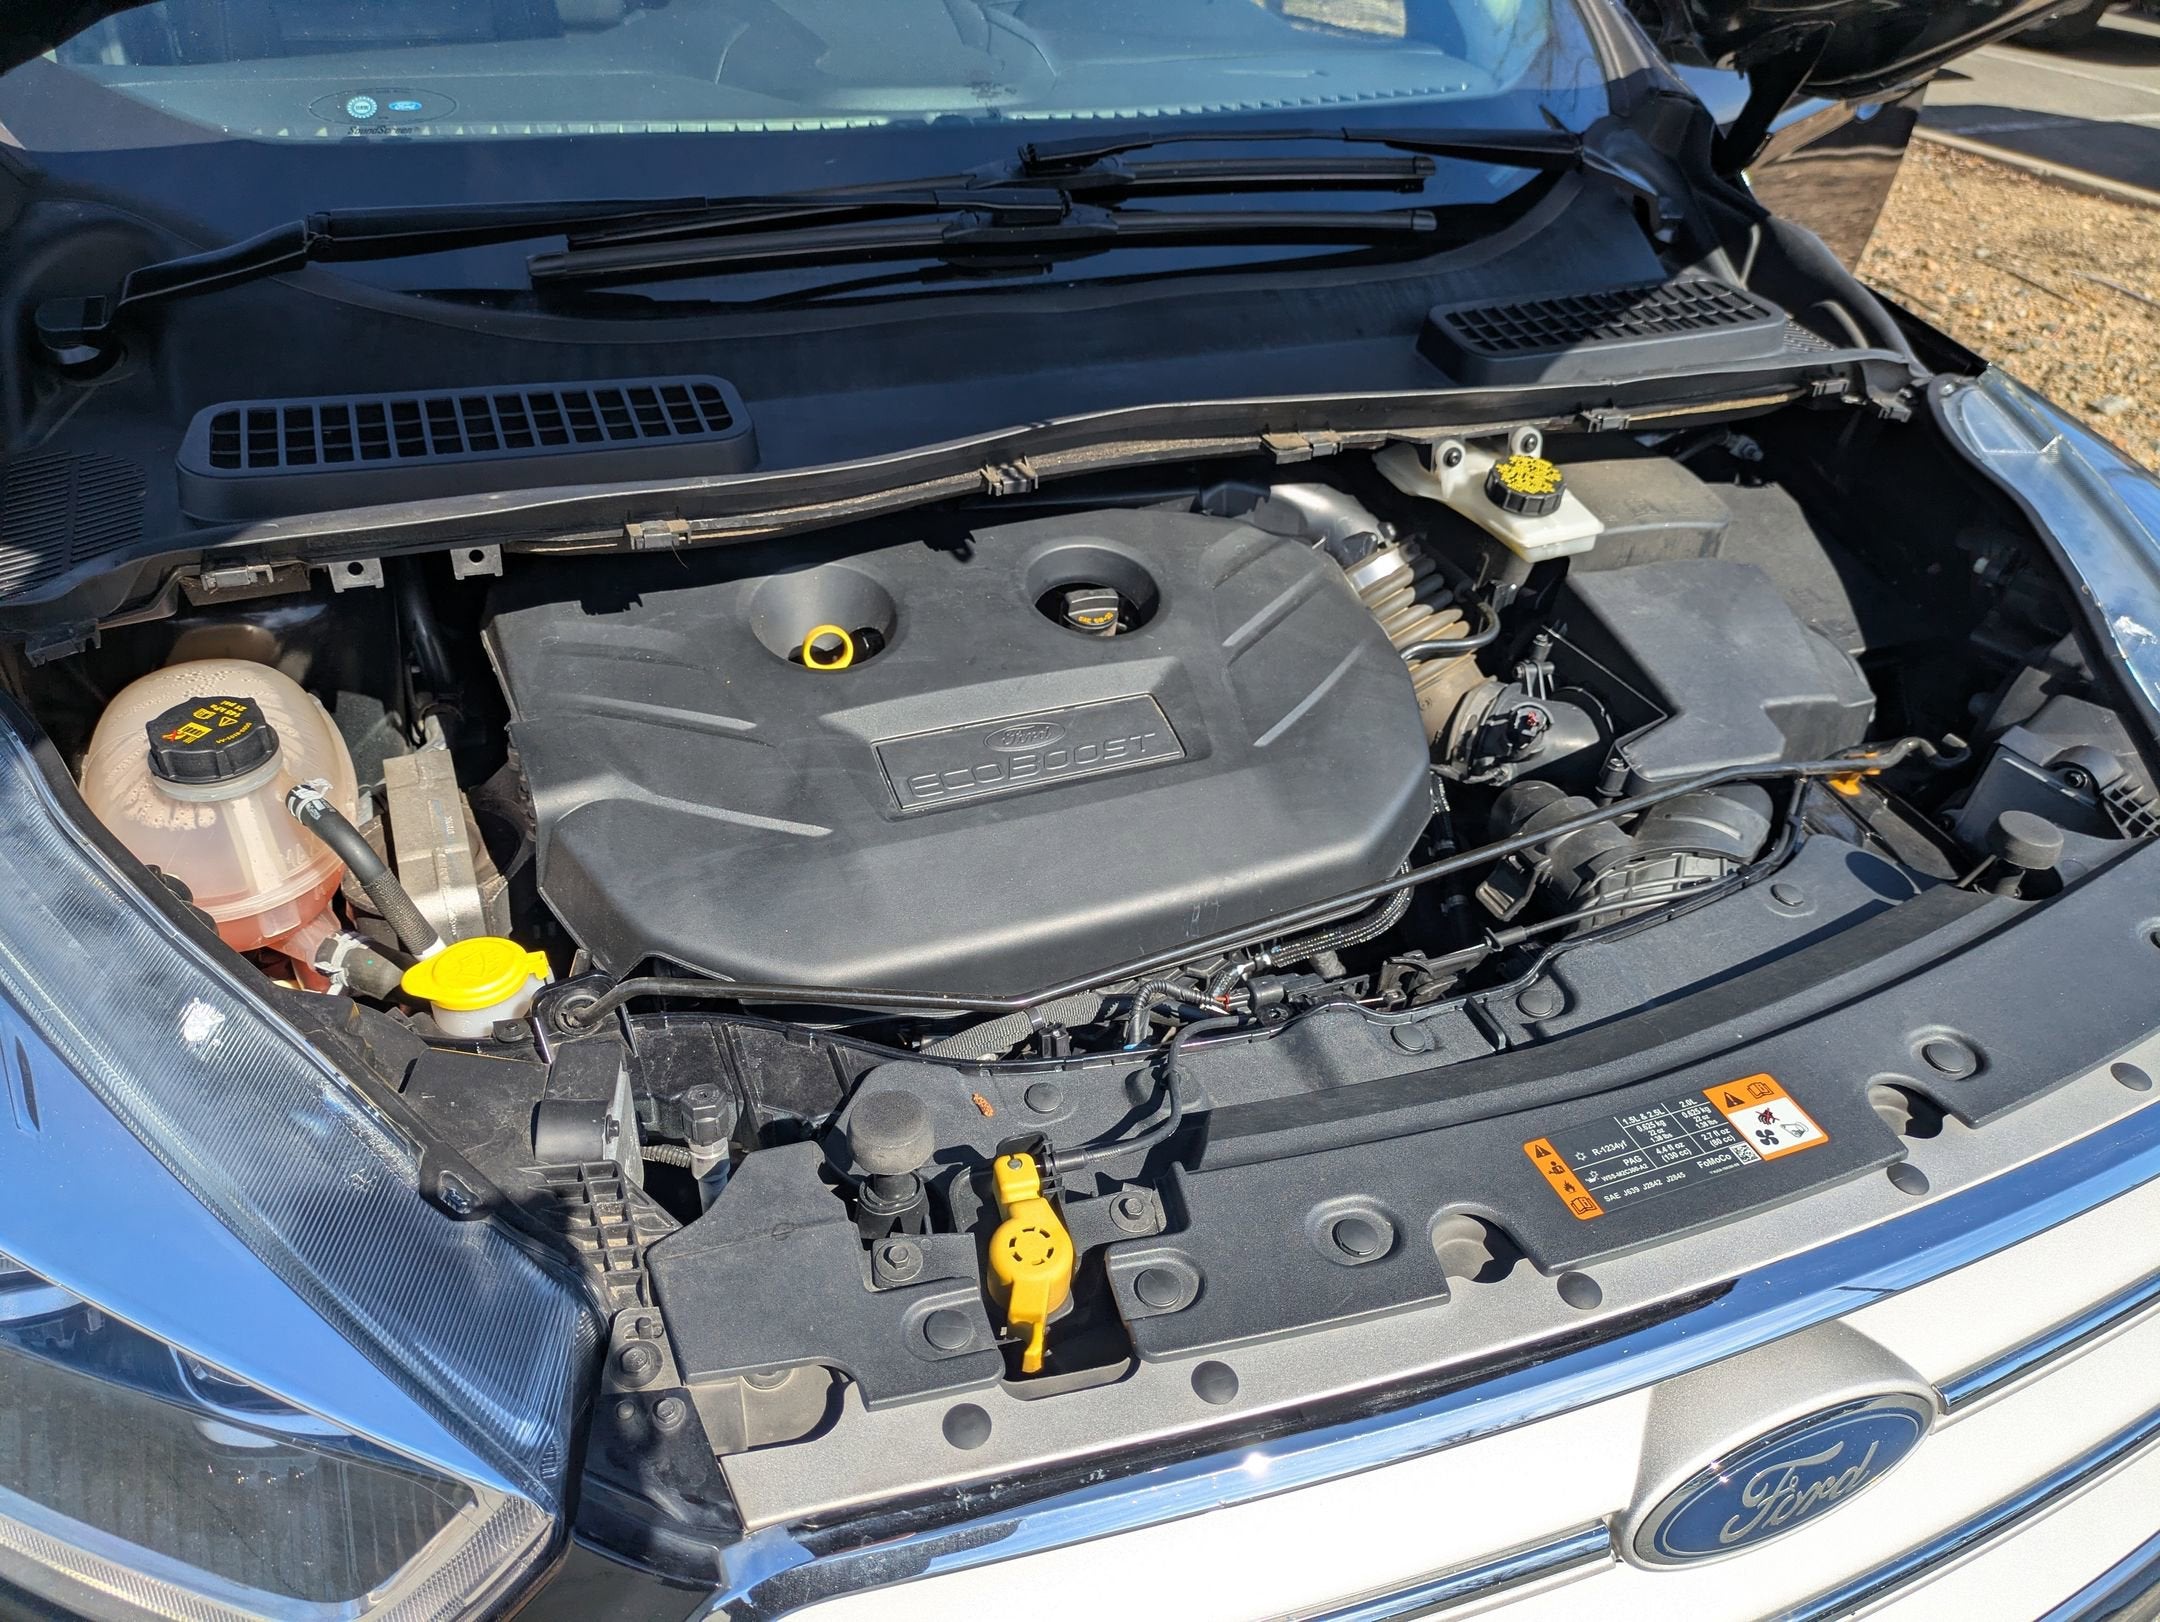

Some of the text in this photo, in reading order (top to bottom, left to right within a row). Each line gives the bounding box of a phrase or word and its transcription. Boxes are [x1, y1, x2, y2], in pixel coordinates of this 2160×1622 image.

[1000, 723, 1052, 746] Ford
[907, 731, 1157, 799] ECOBOOST
[1679, 1099, 1698, 1108] 2.0L
[1622, 1115, 1640, 1126] 1.5L
[1647, 1108, 1666, 1119] 2.5L
[1681, 1106, 1712, 1119] 0.625 kg
[1636, 1119, 1667, 1133] 0.625 kg
[1701, 1132, 1714, 1141] 2.7
[1720, 1128, 1731, 1136] oz
[1709, 1135, 1736, 1148] (80 cc)
[1591, 1140, 1628, 1156] R-1234yf
[1655, 1146, 1670, 1155] 4.4
[1675, 1142, 1686, 1150] oz
[1661, 1148, 1693, 1163] (130 cc)
[1622, 1156, 1643, 1167] PAG
[1696, 1154, 1732, 1169] FoMoCo
[1604, 1192, 1621, 1202] SAE
[1623, 1187, 1640, 1197] J639
[1719, 1440, 1879, 1544] Ford
